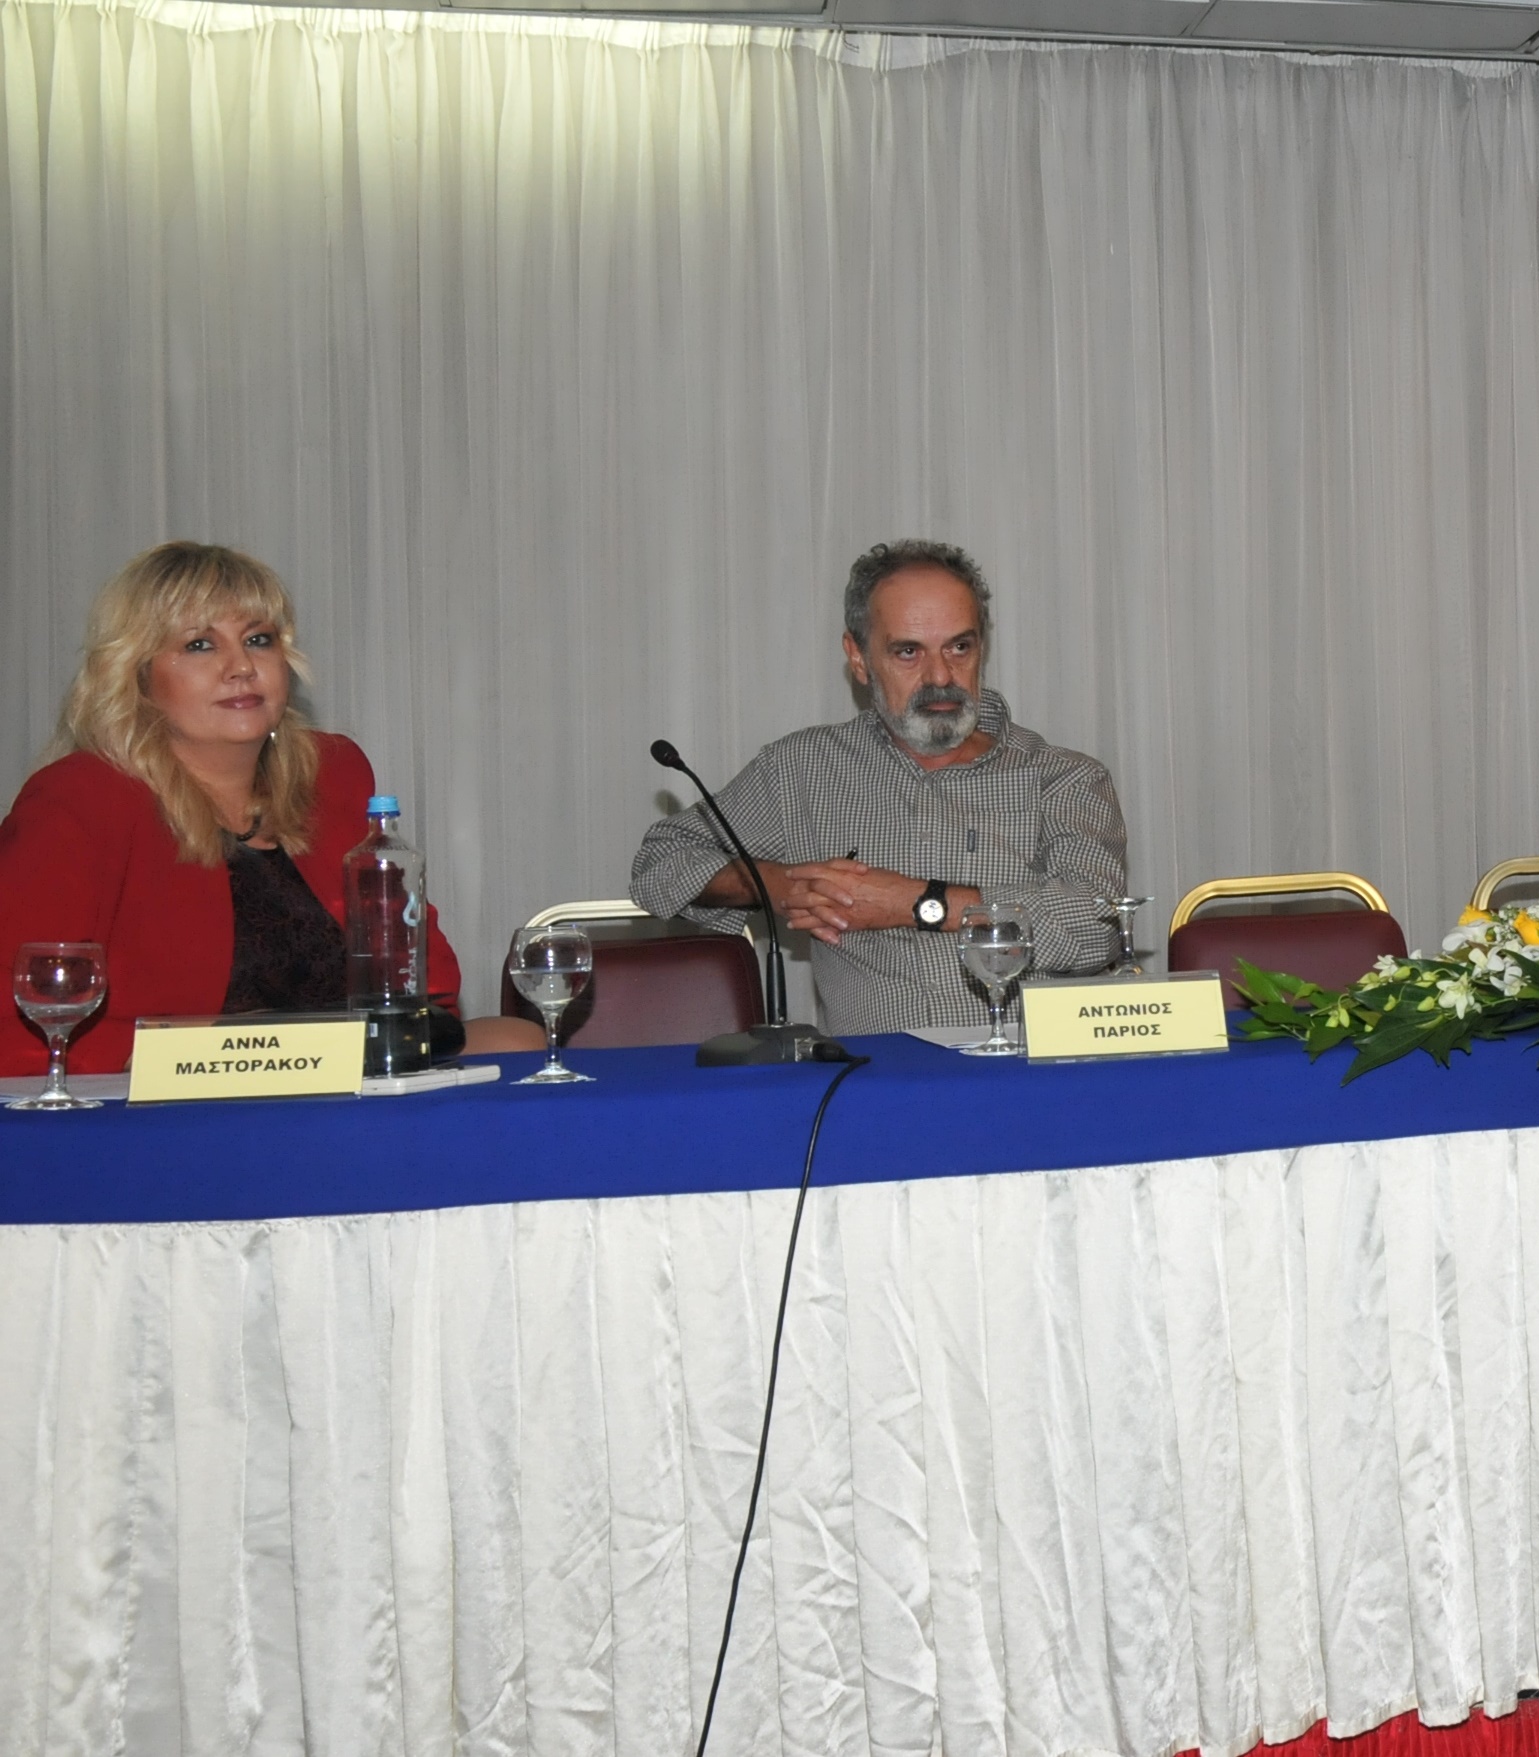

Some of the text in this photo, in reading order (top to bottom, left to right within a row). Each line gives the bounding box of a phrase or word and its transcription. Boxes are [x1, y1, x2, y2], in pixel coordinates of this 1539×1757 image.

[1078, 1002, 1173, 1018] ΑΝΤΩΝΙΟΣ
[1093, 1024, 1162, 1039] ΠΑΡΙΟΣ
[221, 1036, 281, 1051] ΑΝΝΑ
[175, 1056, 324, 1075] ΜΑΣΤΟΡΑΚΟΥ
